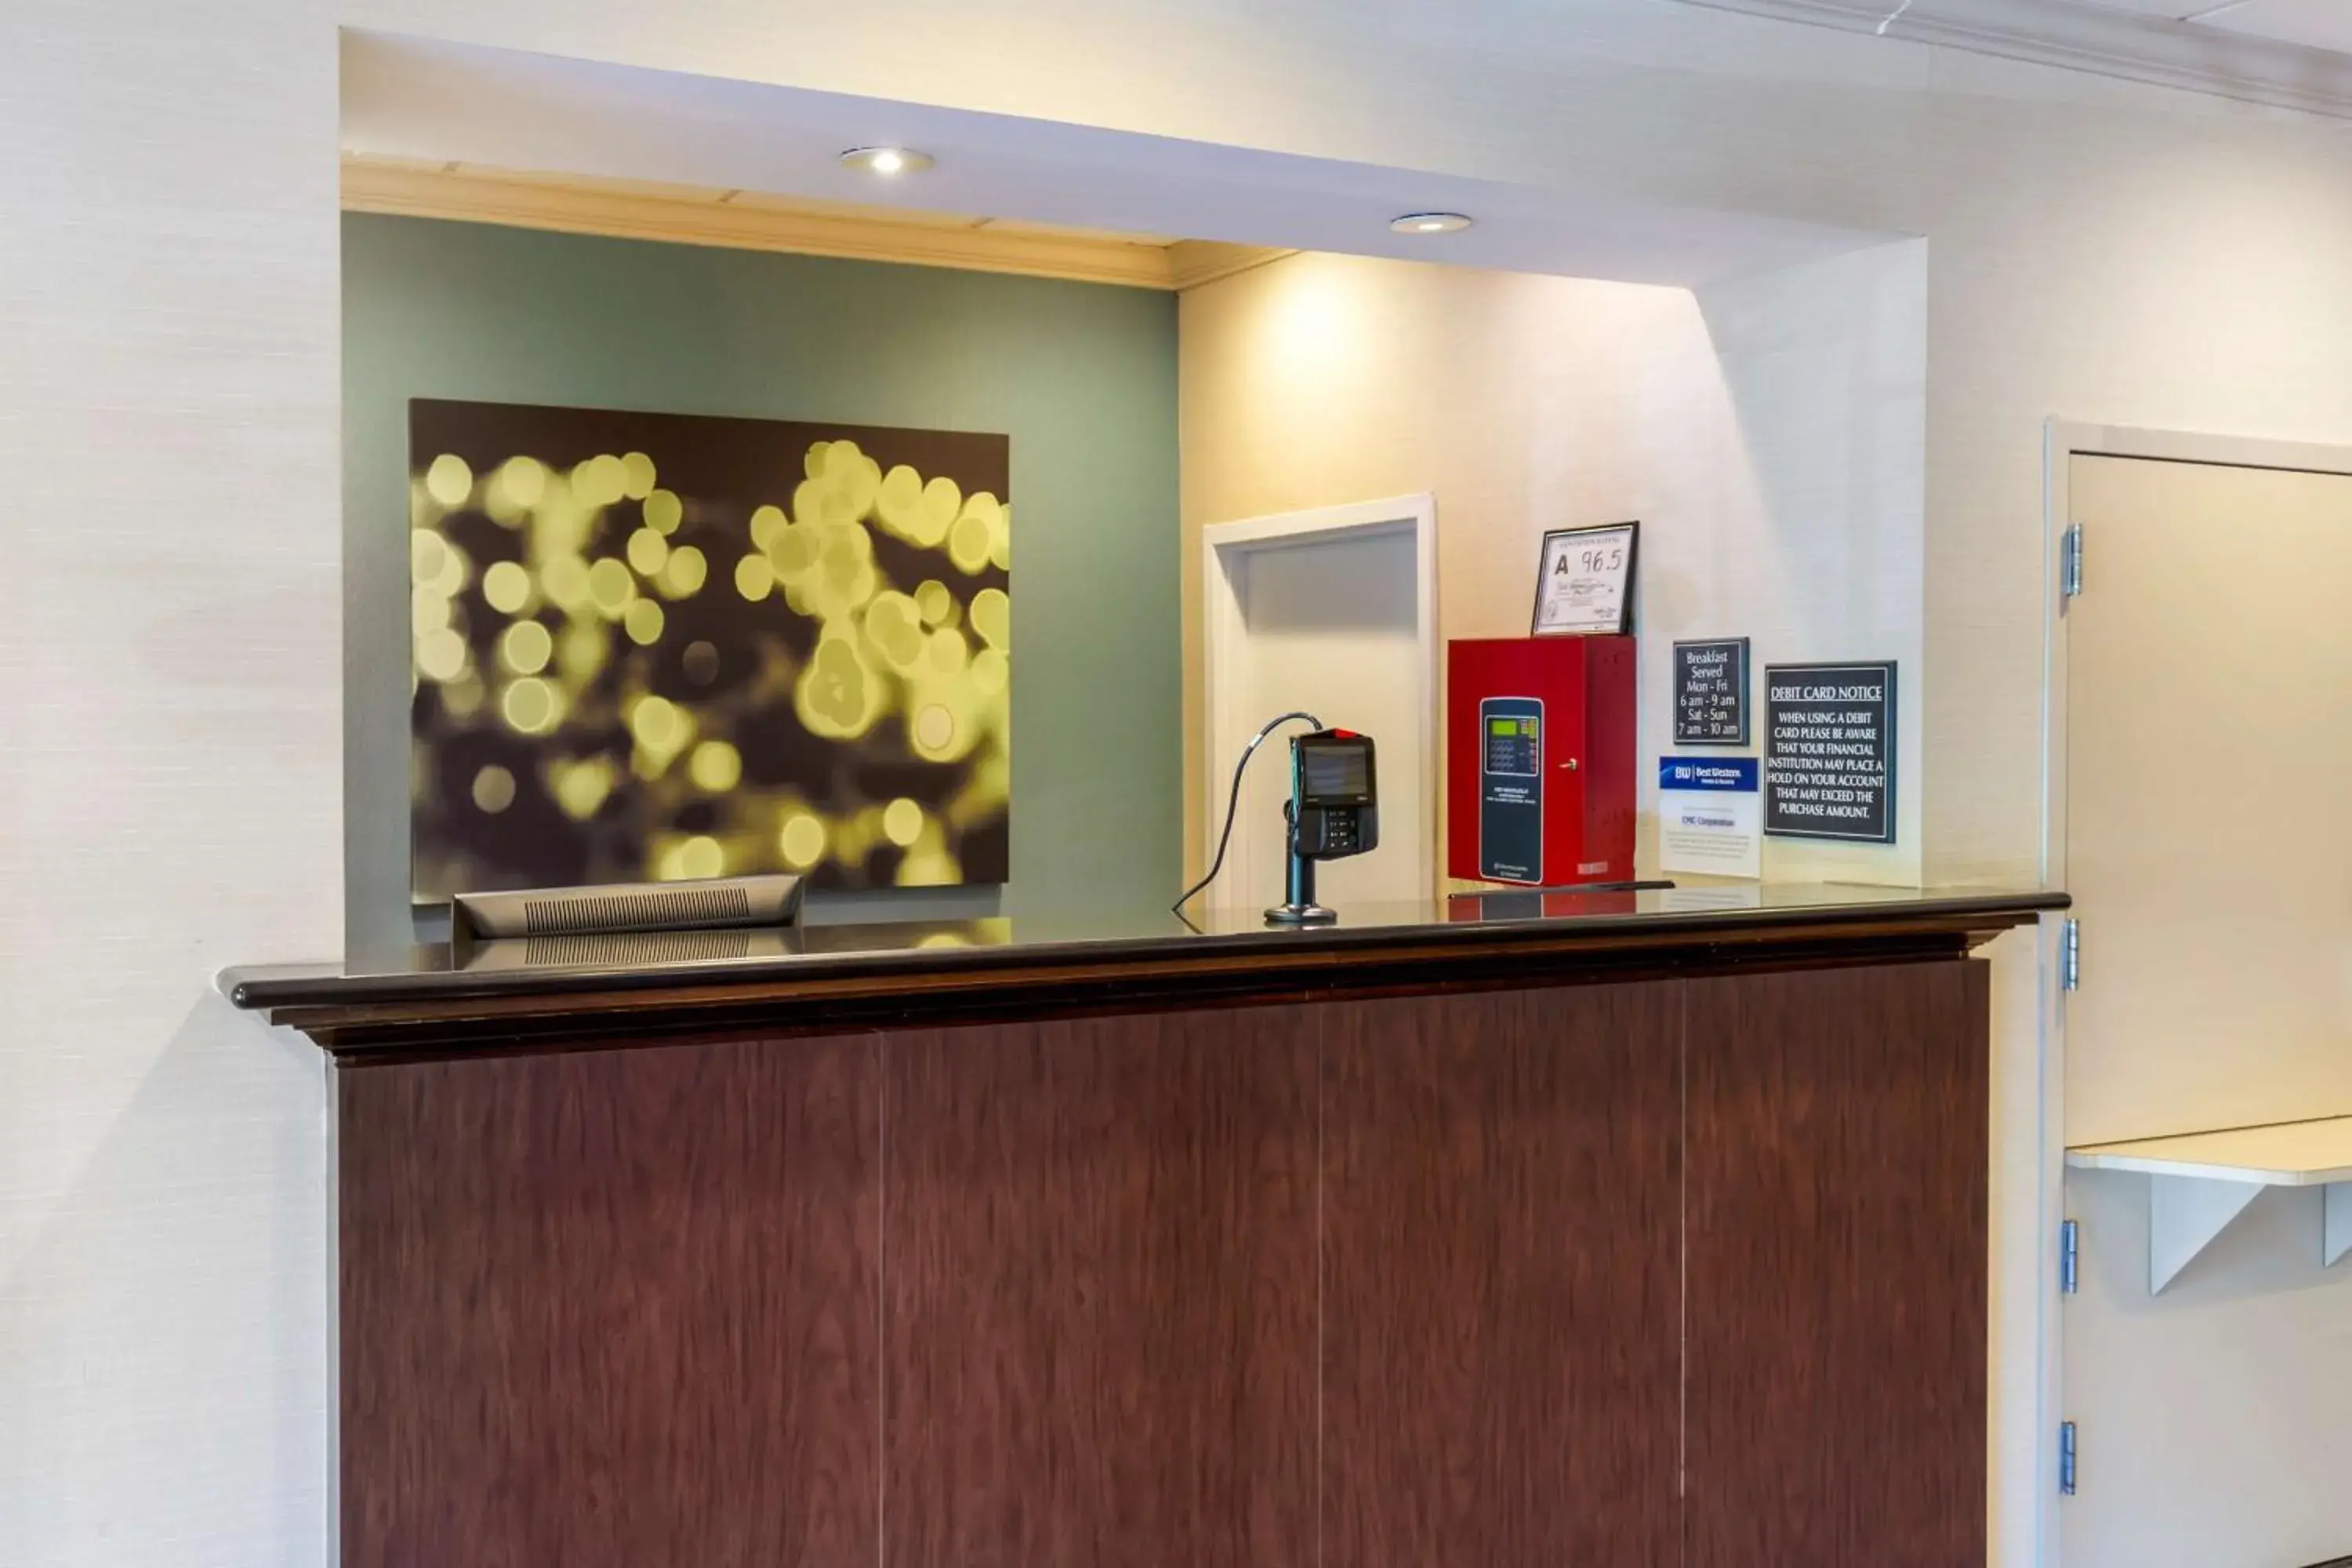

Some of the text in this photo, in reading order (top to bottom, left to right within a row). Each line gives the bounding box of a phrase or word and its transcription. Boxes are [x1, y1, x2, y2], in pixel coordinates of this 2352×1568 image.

[1555, 554, 1569, 575] A
[1581, 549, 1622, 573] 96.5
[1686, 650, 1728, 664] Breakfast
[1691, 664, 1722, 678] Served
[1686, 681, 1708, 692] Mon
[1716, 679, 1728, 691] Fri
[1770, 686, 1882, 699] DEBIT CARD NOTICE
[1680, 695, 1686, 706] 6
[1688, 697, 1704, 706] am
[1711, 694, 1718, 706] 9
[1720, 696, 1735, 706] am
[1688, 708, 1702, 720] Sat
[1710, 708, 1727, 720] Sun
[1778, 712, 1873, 724] WHEN USING A DEBIT
[1679, 722, 1686, 735] 7
[1686, 725, 1701, 735] am
[1711, 722, 1721, 735] 10
[1722, 725, 1738, 735] am
[1774, 727, 1877, 739] CARD PLEASE BE AWARE
[1776, 742, 1874, 755] THAT YOUR FINANCIAL
[1768, 757, 1883, 771] INSTITUTION MAY PLACE A
[1697, 767, 1711, 777] Best
[1768, 772, 1884, 787] HOLD ON YOUR ACCOUNT
[1776, 787, 1874, 803] THAT MAY EXCEED THE
[1779, 802, 1870, 818] PURCHASE AMOUNT.
